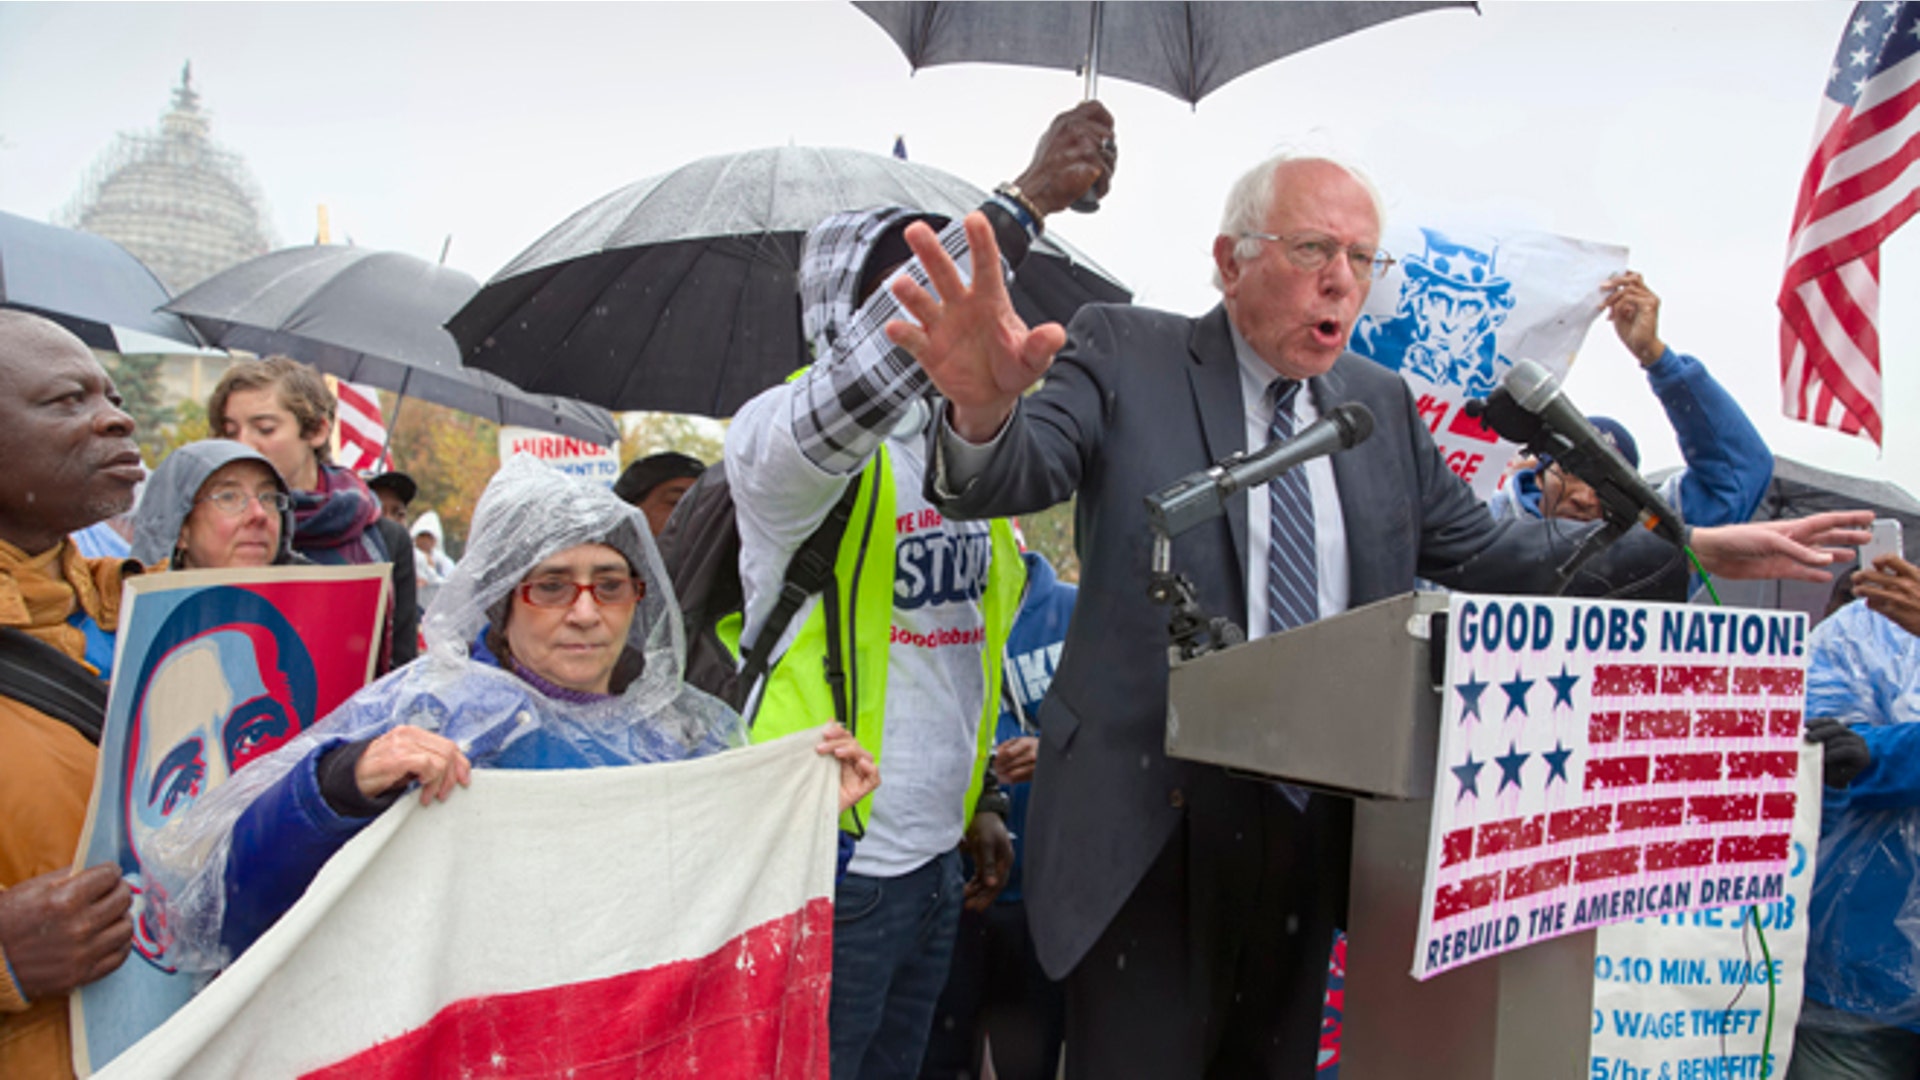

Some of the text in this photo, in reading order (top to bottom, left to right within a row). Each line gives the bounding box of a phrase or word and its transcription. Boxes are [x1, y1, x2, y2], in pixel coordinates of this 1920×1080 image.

[598, 460, 617, 475] TO
[1459, 601, 1805, 656] GOOD JOBS NATION!
[1425, 873, 1784, 970] REBUILD THE AMERICAN DREAM
[1660, 959, 1711, 985] MIN.
[1719, 959, 1784, 985] WAGE
[1613, 1009, 1686, 1039] WAGE
[1690, 1009, 1762, 1035] THEFT
[1678, 1053, 1776, 1080] BENEFITS
